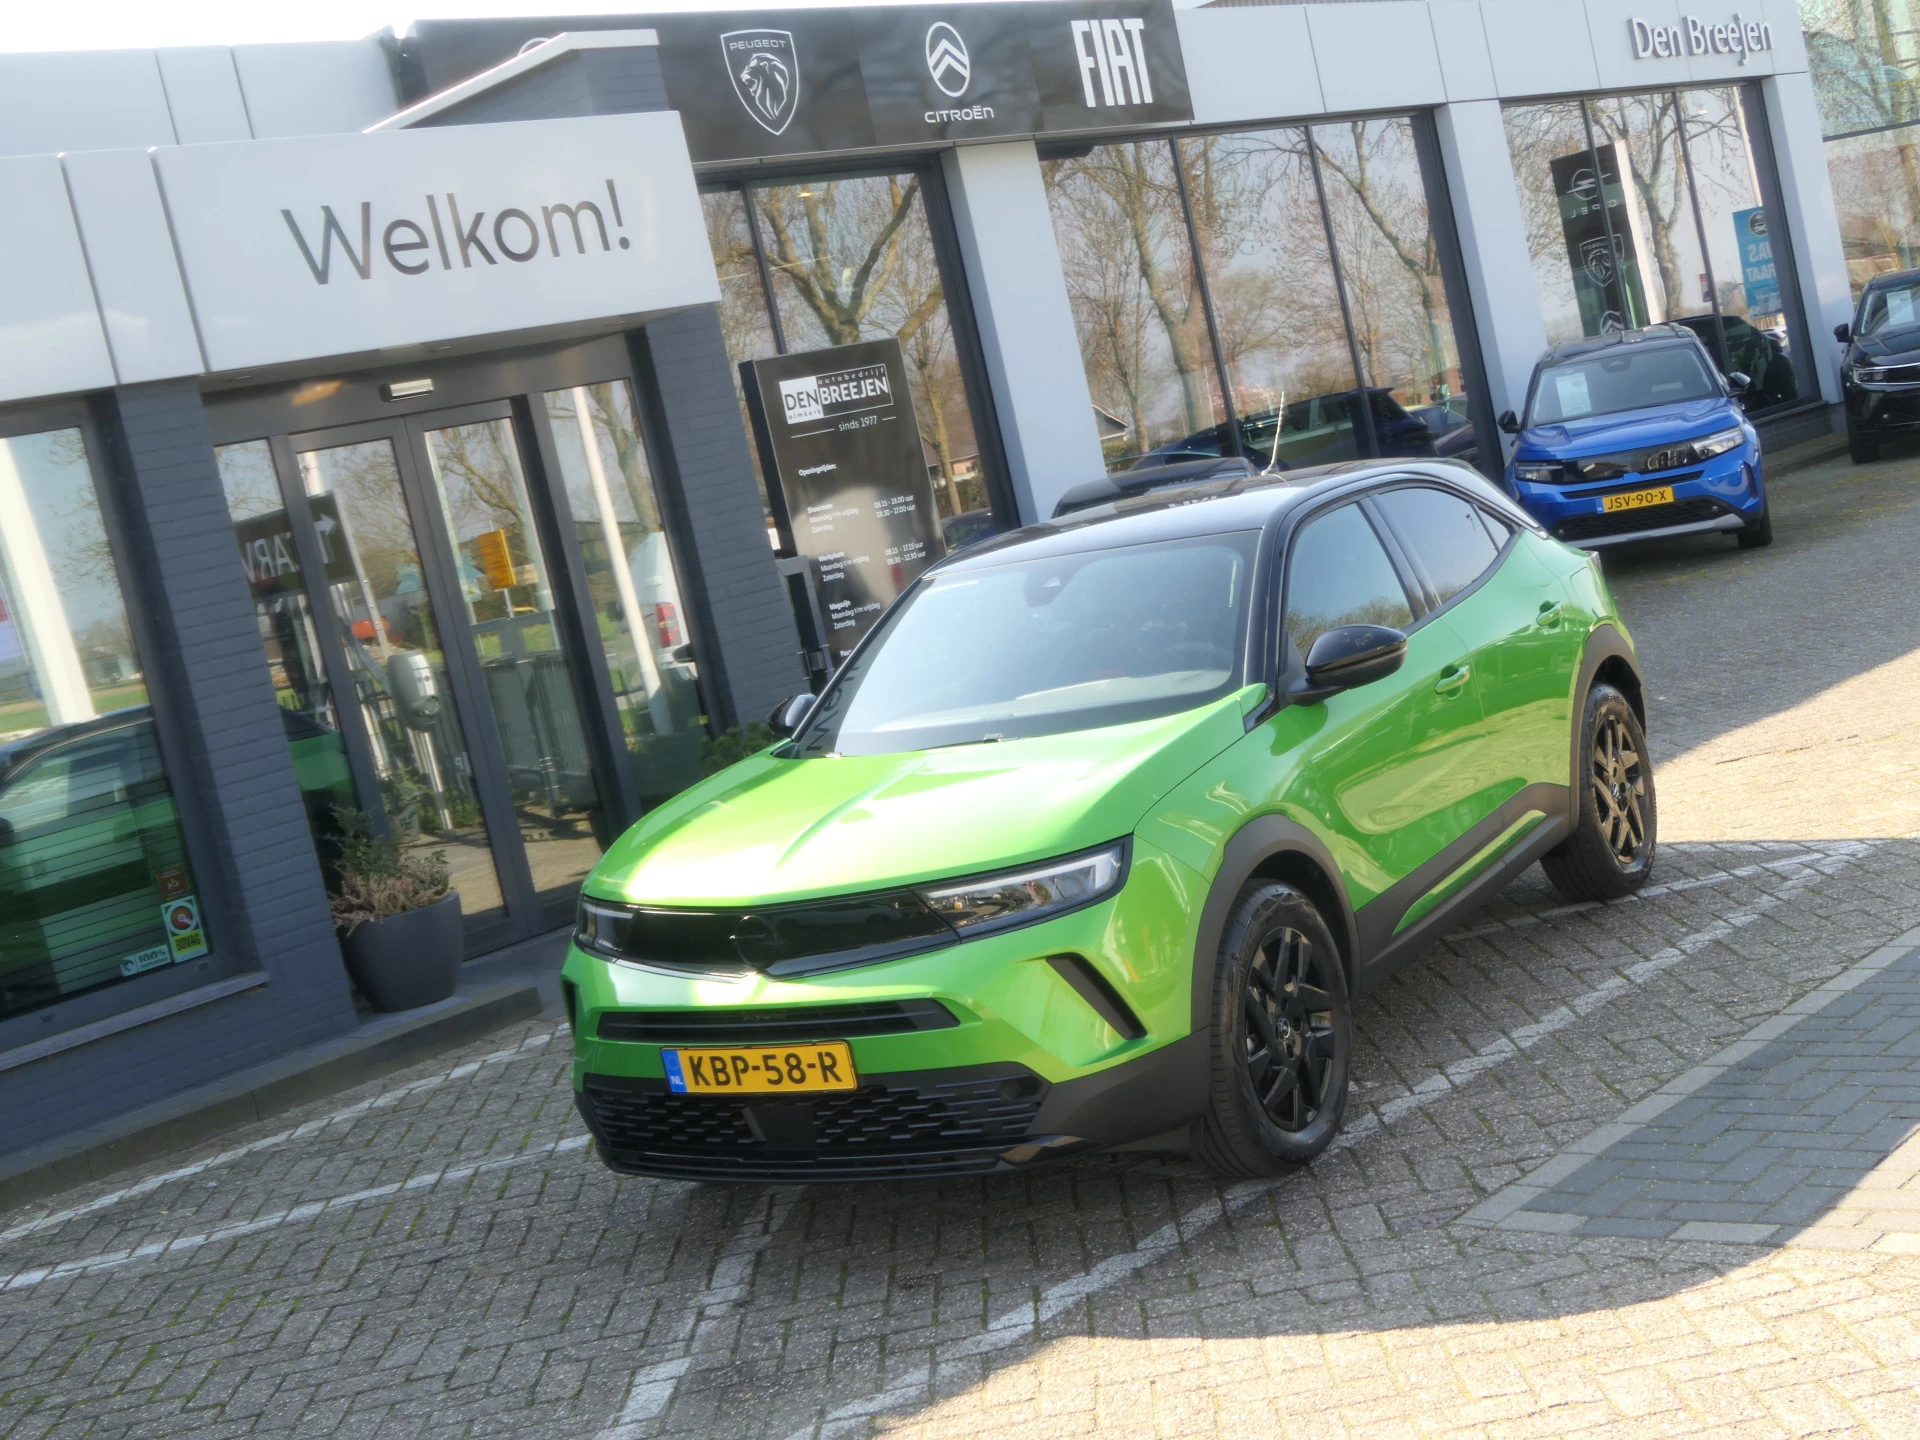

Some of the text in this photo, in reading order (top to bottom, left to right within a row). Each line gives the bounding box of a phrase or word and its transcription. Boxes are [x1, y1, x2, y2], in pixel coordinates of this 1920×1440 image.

[729, 40, 786, 51] PEUGEOT
[1627, 12, 1774, 66] Den Breejen
[1071, 18, 1153, 108] FIAT
[280, 178, 630, 285] Welkom!
[818, 367, 884, 385] autobedrijf
[784, 377, 889, 411] DEN BREEJEN
[838, 416, 877, 432] sinds 1977
[1608, 490, 1667, 510] JSV-90-X
[820, 561, 844, 572] Maandag
[822, 571, 845, 582] Zaterdag
[831, 609, 855, 620] Maandag
[834, 619, 856, 630] Zaterdag
[175, 932, 201, 952] BOVAG
[688, 1051, 843, 1087] KBP-58-R
[670, 1075, 684, 1086] NL
